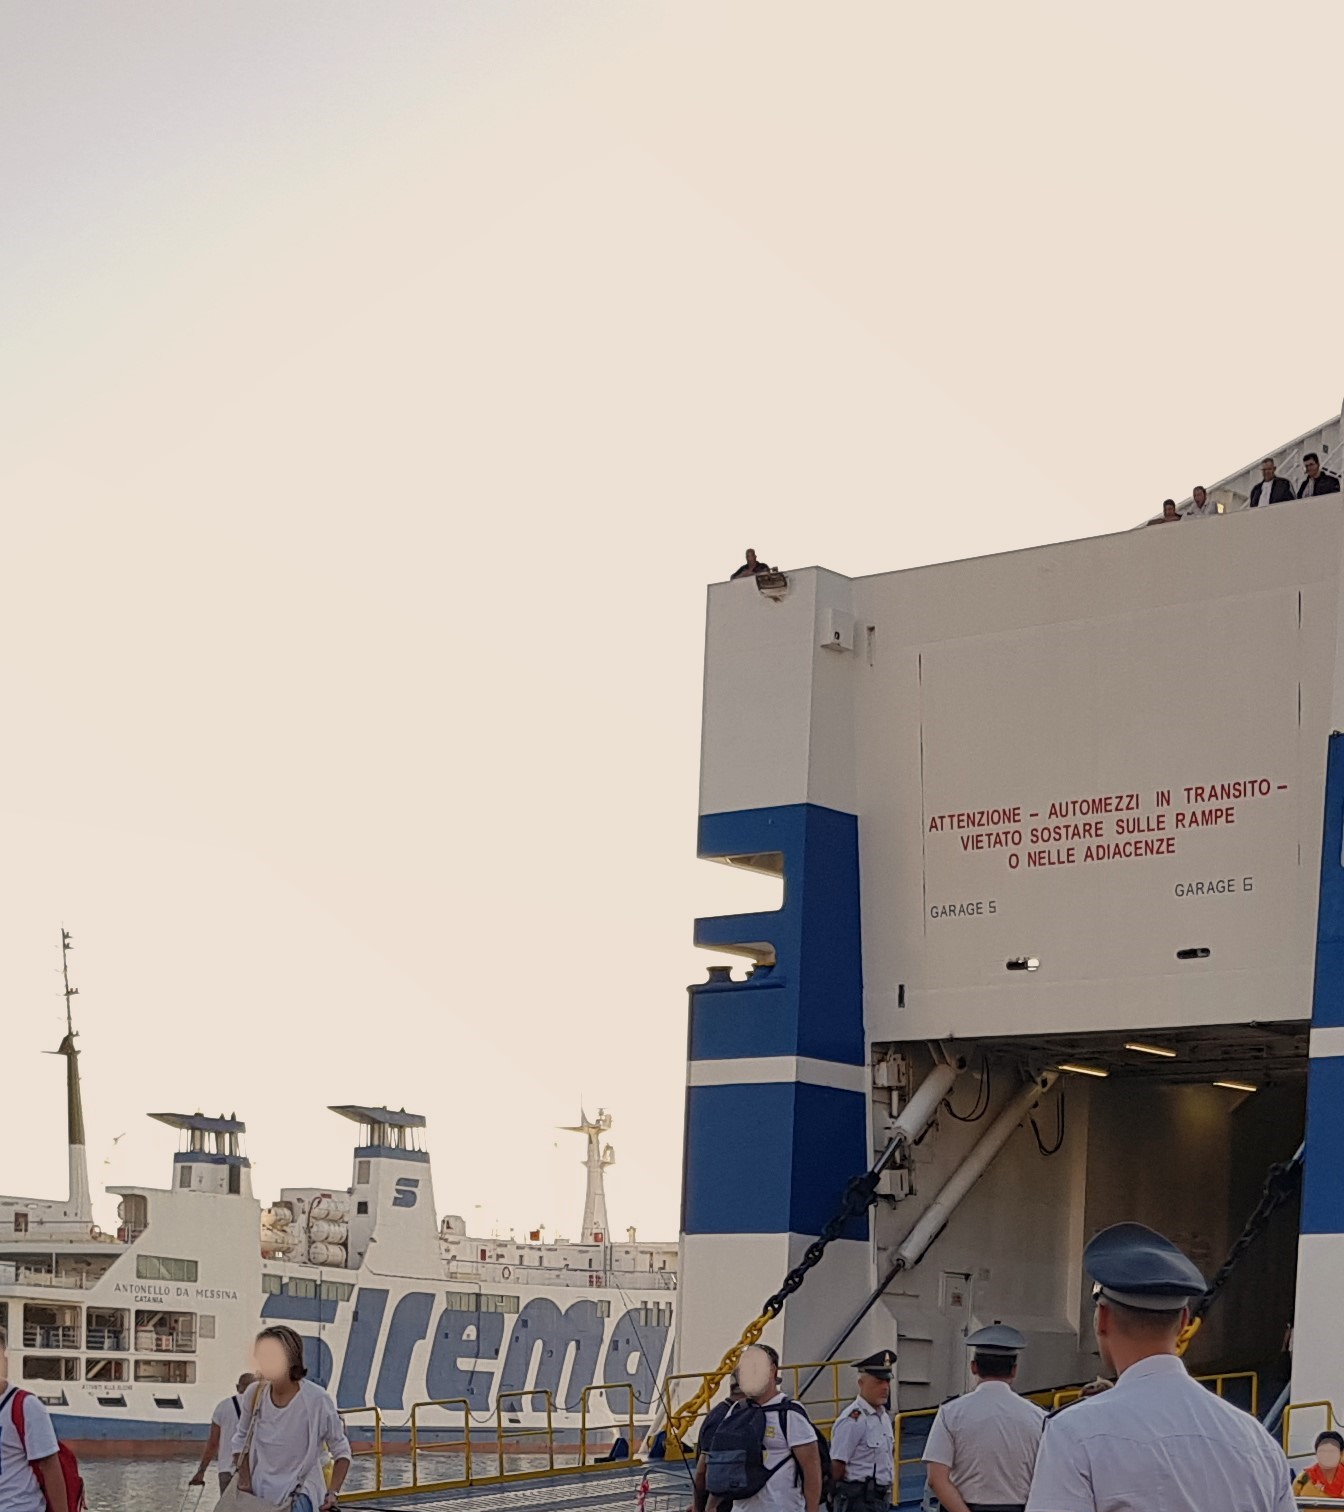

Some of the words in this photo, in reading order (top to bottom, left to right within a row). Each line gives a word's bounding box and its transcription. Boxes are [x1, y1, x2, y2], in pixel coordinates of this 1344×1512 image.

[928, 806, 1022, 832] ATTENZIONE
[1048, 793, 1141, 819] AUTOMEZZI
[1155, 789, 1172, 808] IN
[1183, 778, 1272, 805] TRANSITO
[960, 829, 1022, 852] VIETATO
[1030, 821, 1104, 846] SOSTARE
[1115, 813, 1166, 835] SULLE
[1175, 806, 1236, 830] RAMPE
[1008, 853, 1020, 870] O
[1027, 846, 1076, 868] NELLE
[1083, 836, 1176, 863] ADIACENZE
[1174, 879, 1236, 898] GARAGE
[1242, 876, 1254, 892] 6
[930, 902, 984, 919] GARAGE
[988, 900, 997, 914] 5
[114, 1283, 170, 1296] ANTONELLO
[176, 1288, 190, 1298] DA
[196, 1289, 238, 1300] MESSINA
[134, 1295, 164, 1304] CATANIA
